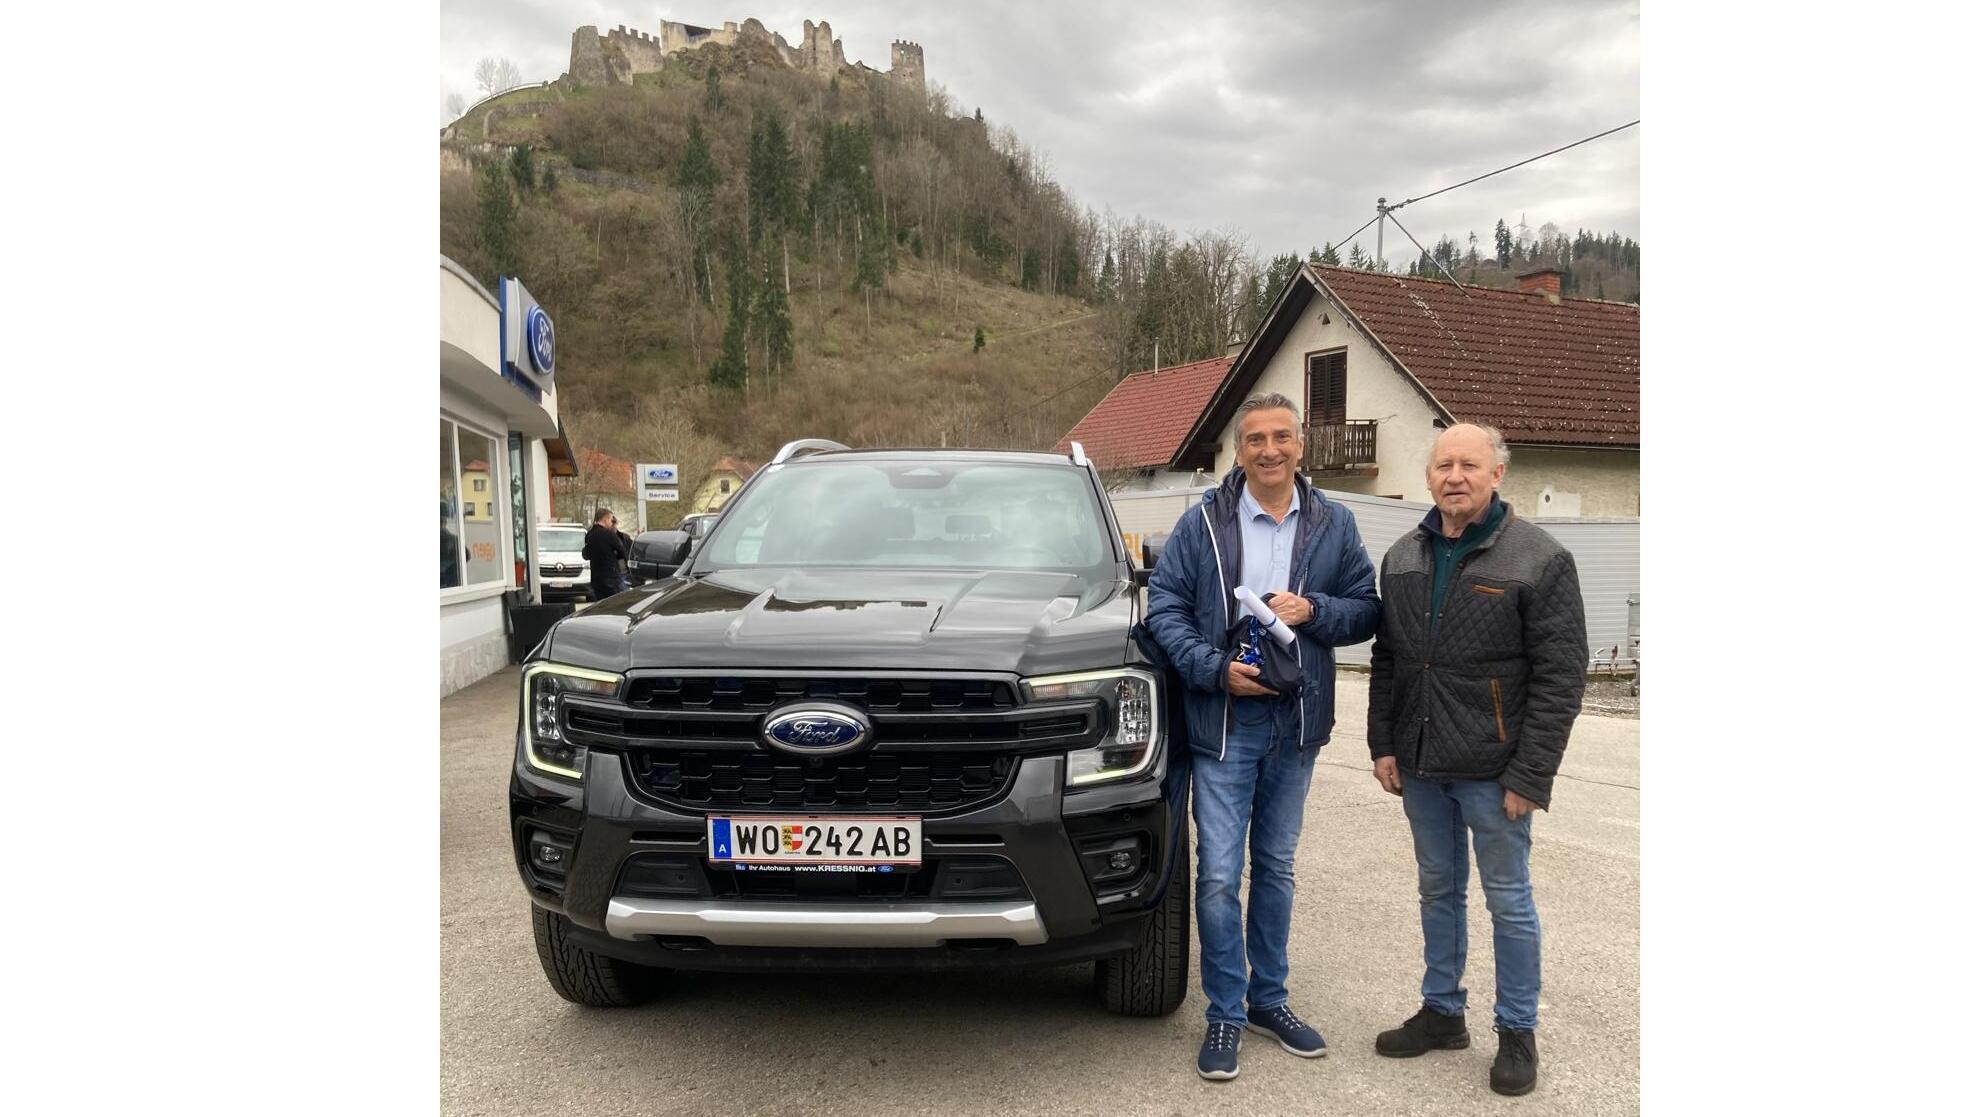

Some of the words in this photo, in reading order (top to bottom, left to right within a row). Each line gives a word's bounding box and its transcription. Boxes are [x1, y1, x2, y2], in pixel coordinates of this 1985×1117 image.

[788, 720, 841, 743] Ford
[735, 825, 780, 855] WO
[719, 844, 727, 853] A
[794, 865, 877, 873] www.KRESSNIG.at
